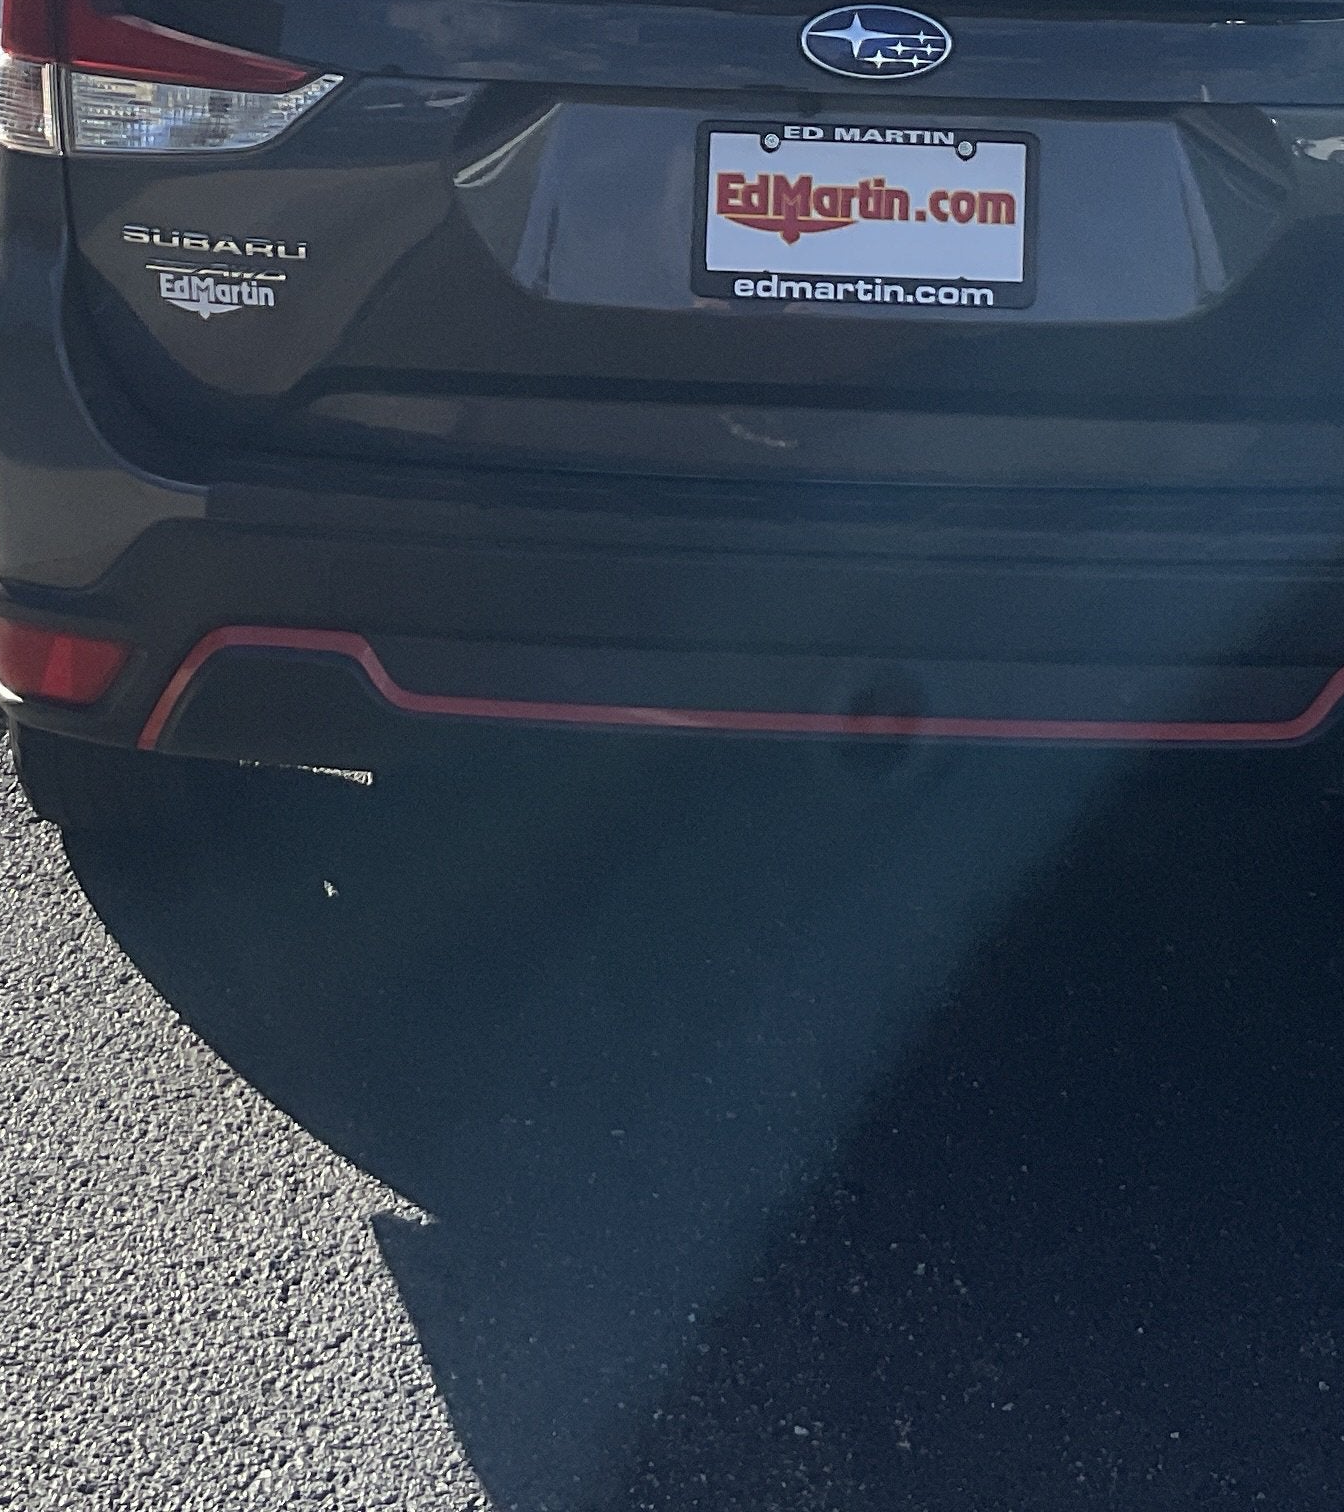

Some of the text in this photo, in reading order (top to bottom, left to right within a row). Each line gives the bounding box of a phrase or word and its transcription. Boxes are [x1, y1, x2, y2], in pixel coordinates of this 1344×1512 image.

[783, 125, 955, 145] ED MARTIN
[716, 172, 1017, 228] EdMartin.com
[122, 223, 309, 260] SUBARU
[733, 275, 995, 306] edmartin.com
